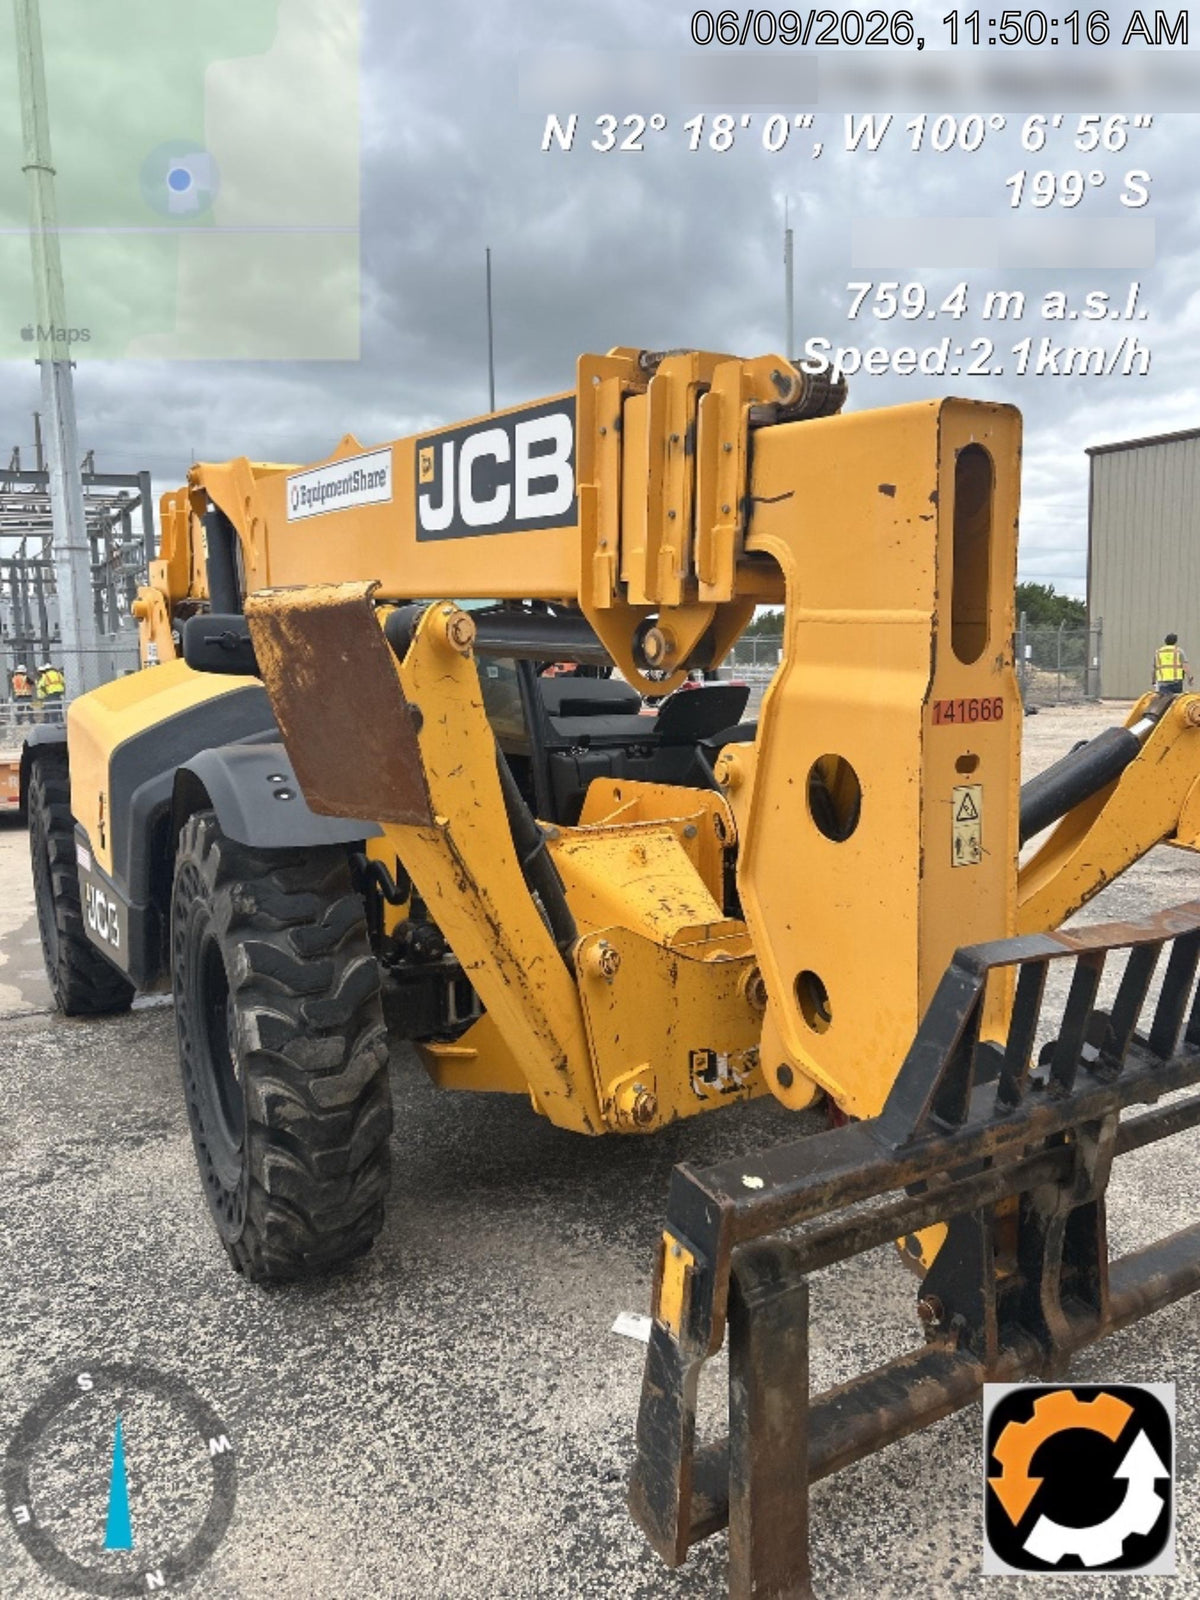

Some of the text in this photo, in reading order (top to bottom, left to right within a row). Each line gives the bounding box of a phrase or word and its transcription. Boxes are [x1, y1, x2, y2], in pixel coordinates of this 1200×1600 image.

[300, 468, 387, 508] EquipmentShare
[419, 413, 574, 531] JCB
[933, 697, 1004, 724] 141666
[87, 886, 120, 948] JCB
